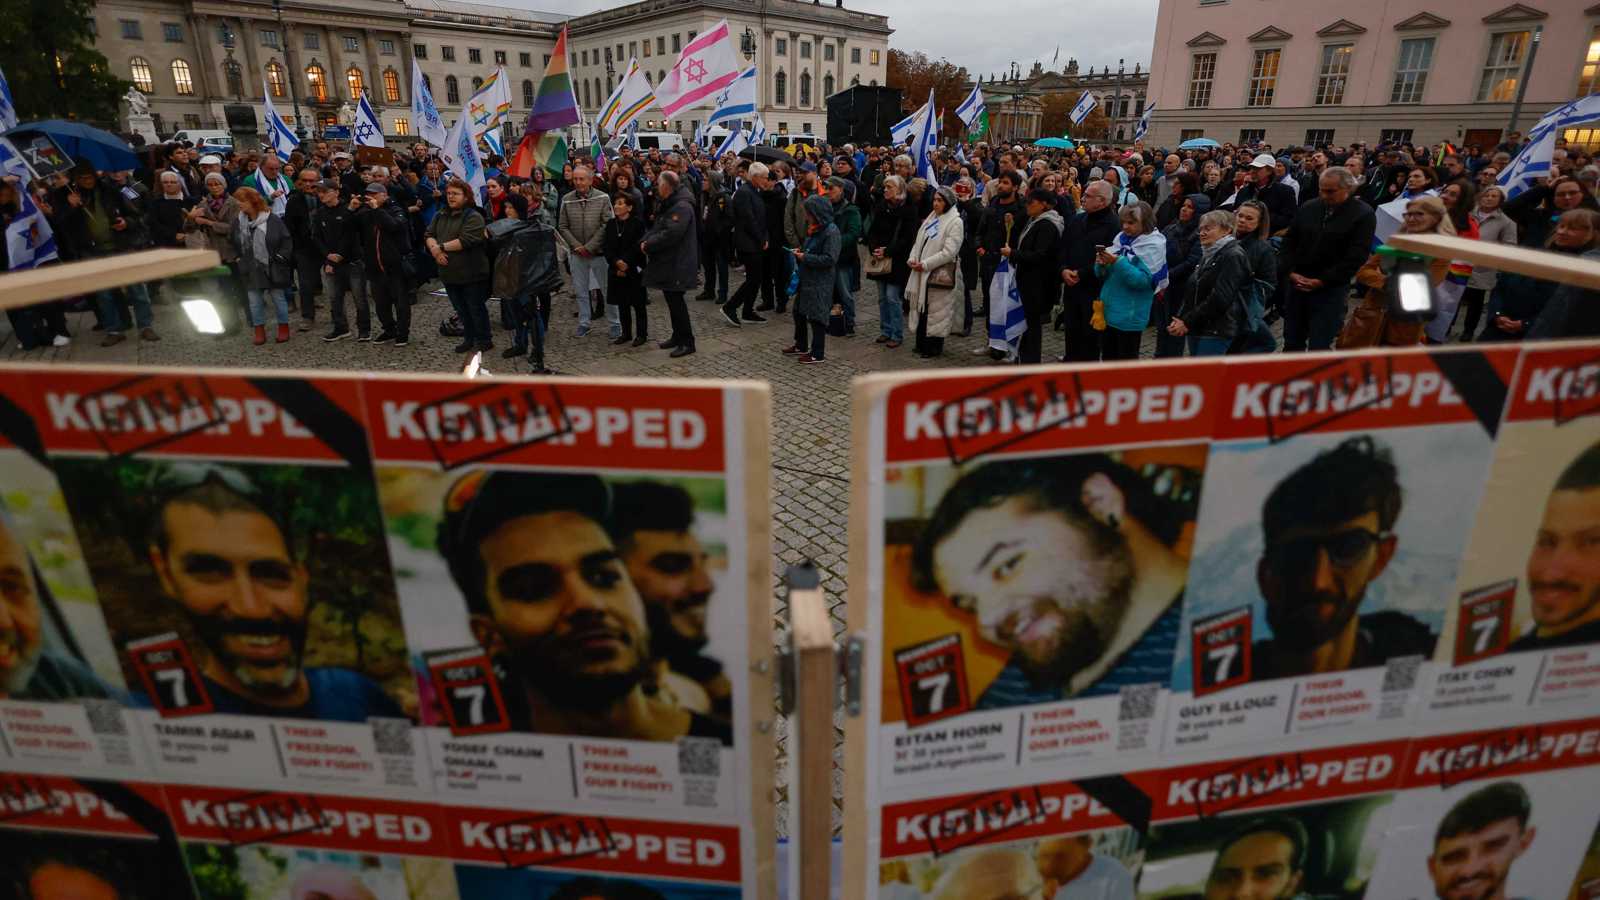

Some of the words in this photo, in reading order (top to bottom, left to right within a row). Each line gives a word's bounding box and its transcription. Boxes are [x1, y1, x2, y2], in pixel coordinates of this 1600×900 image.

[381, 400, 708, 450] KIDNAPPED
[903, 384, 1204, 441] KIDNAPPED
[1471, 616, 1499, 655] 7
[1208, 643, 1239, 684] 7
[156, 668, 189, 707] 7
[452, 685, 487, 725] 7
[917, 672, 949, 713] 7
[1180, 702, 1215, 718] GUY
[895, 731, 947, 747] EITAN
[952, 722, 1003, 739] HORN
[1414, 729, 1600, 776] KIDNAPPE
[1167, 753, 1395, 806] KIDNAPPED
[181, 799, 433, 843] KIDNAPPED
[459, 820, 727, 867] KIDNAPPED
